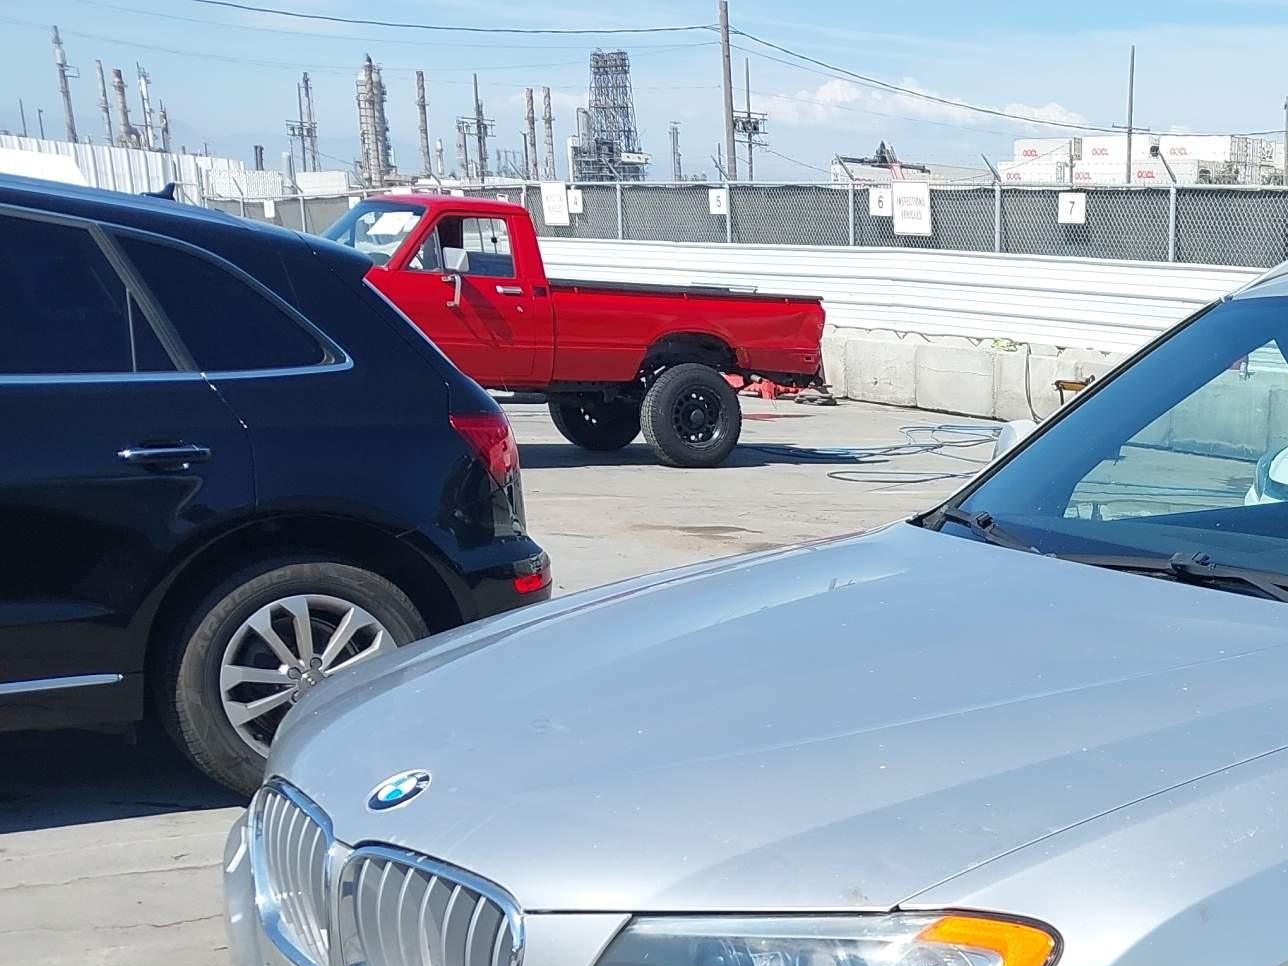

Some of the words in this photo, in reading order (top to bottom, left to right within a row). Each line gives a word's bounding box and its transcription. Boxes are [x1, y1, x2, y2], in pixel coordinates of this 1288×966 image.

[716, 195, 722, 208] 5
[877, 195, 884, 209] 6
[1069, 200, 1075, 215] 7
